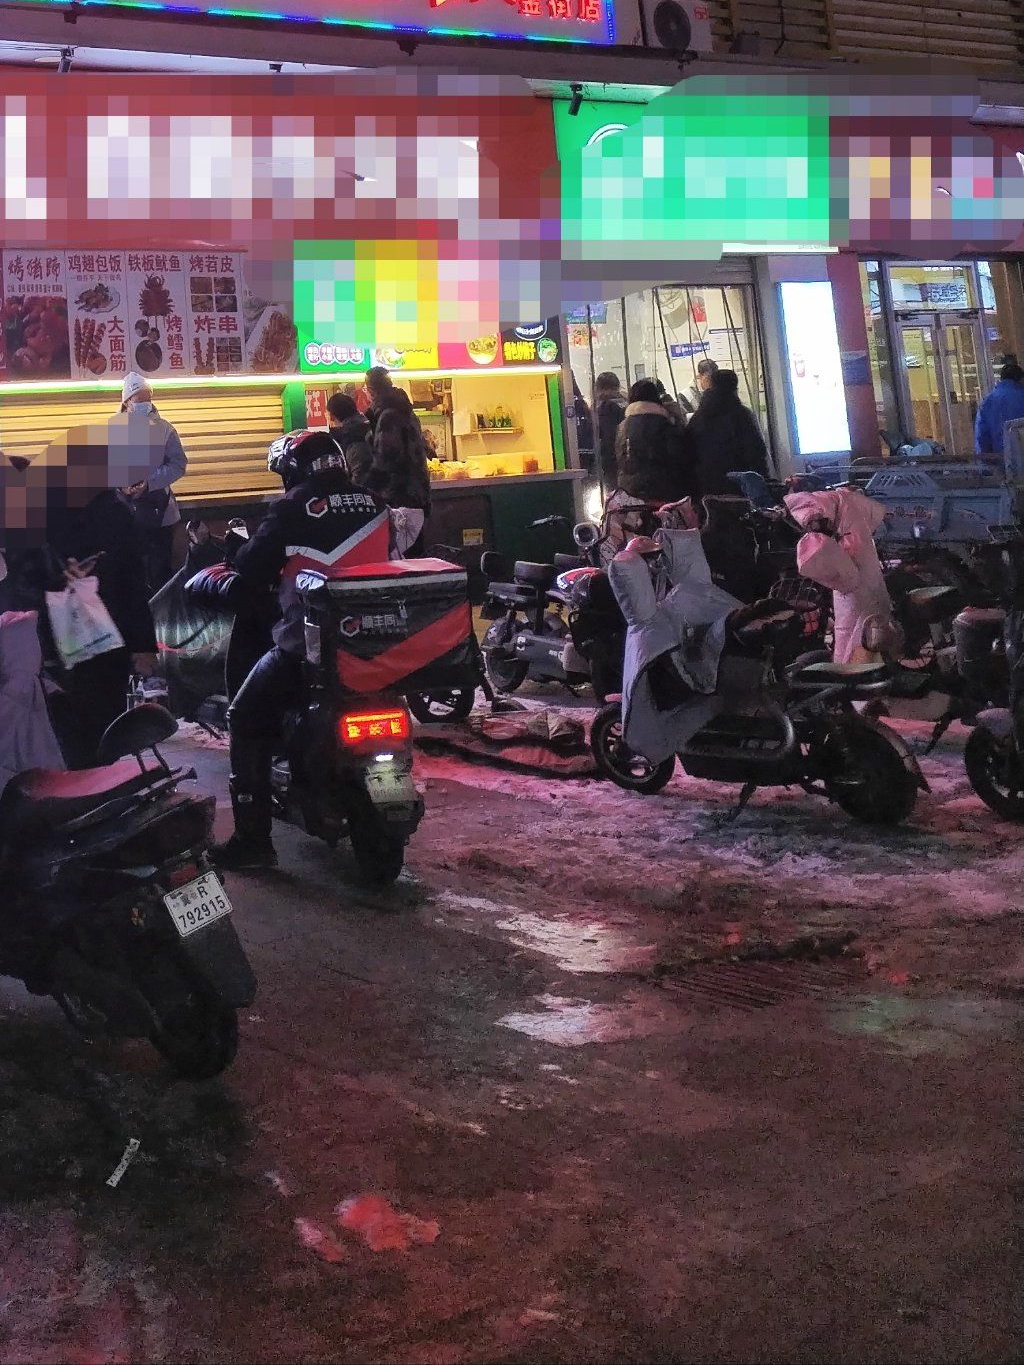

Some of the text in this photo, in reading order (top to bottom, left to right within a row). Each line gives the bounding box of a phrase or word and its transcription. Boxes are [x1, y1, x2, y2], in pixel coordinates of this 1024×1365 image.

[68, 254, 122, 273] 鸡翅包饭
[128, 253, 182, 272] 铁板鱿鱼
[189, 255, 235, 273] 烤苕皮
[194, 315, 238, 333] 炸串
[107, 315, 126, 372] 大面筋
[166, 315, 185, 369] 烤鳕鱼
[178, 895, 226, 928] 792915
